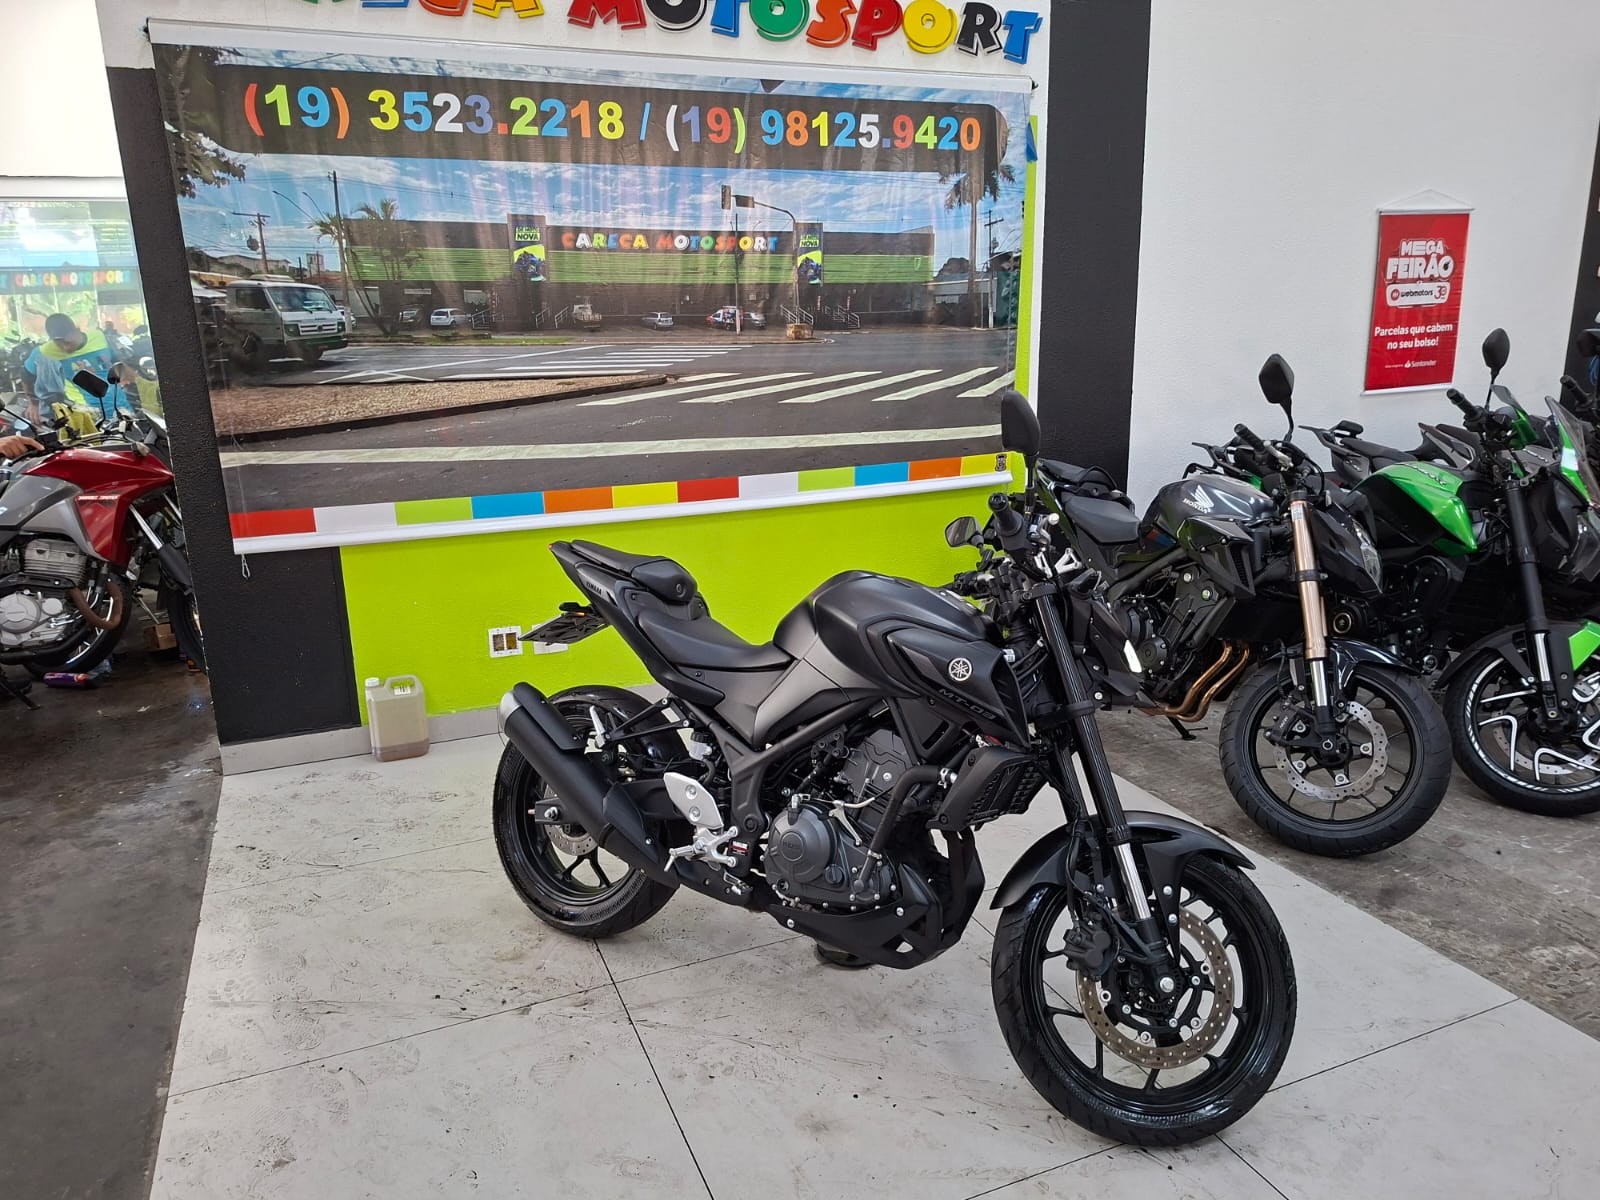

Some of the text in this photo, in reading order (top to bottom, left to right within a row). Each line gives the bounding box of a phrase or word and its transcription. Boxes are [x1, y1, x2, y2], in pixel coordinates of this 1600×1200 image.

[244, 83, 351, 140] (19)
[369, 89, 625, 140] 3523.2218
[665, 103, 747, 154] (19)
[760, 111, 982, 152] 98125.9420
[516, 233, 539, 241] NOVA
[561, 232, 779, 252] CARECA MOTOSPORT
[1400, 240, 1445, 256] MEGA
[1374, 322, 1453, 337] Parcelas que cabem
[1387, 337, 1439, 350] no seu bolso!
[1182, 498, 1211, 514] HONDA
